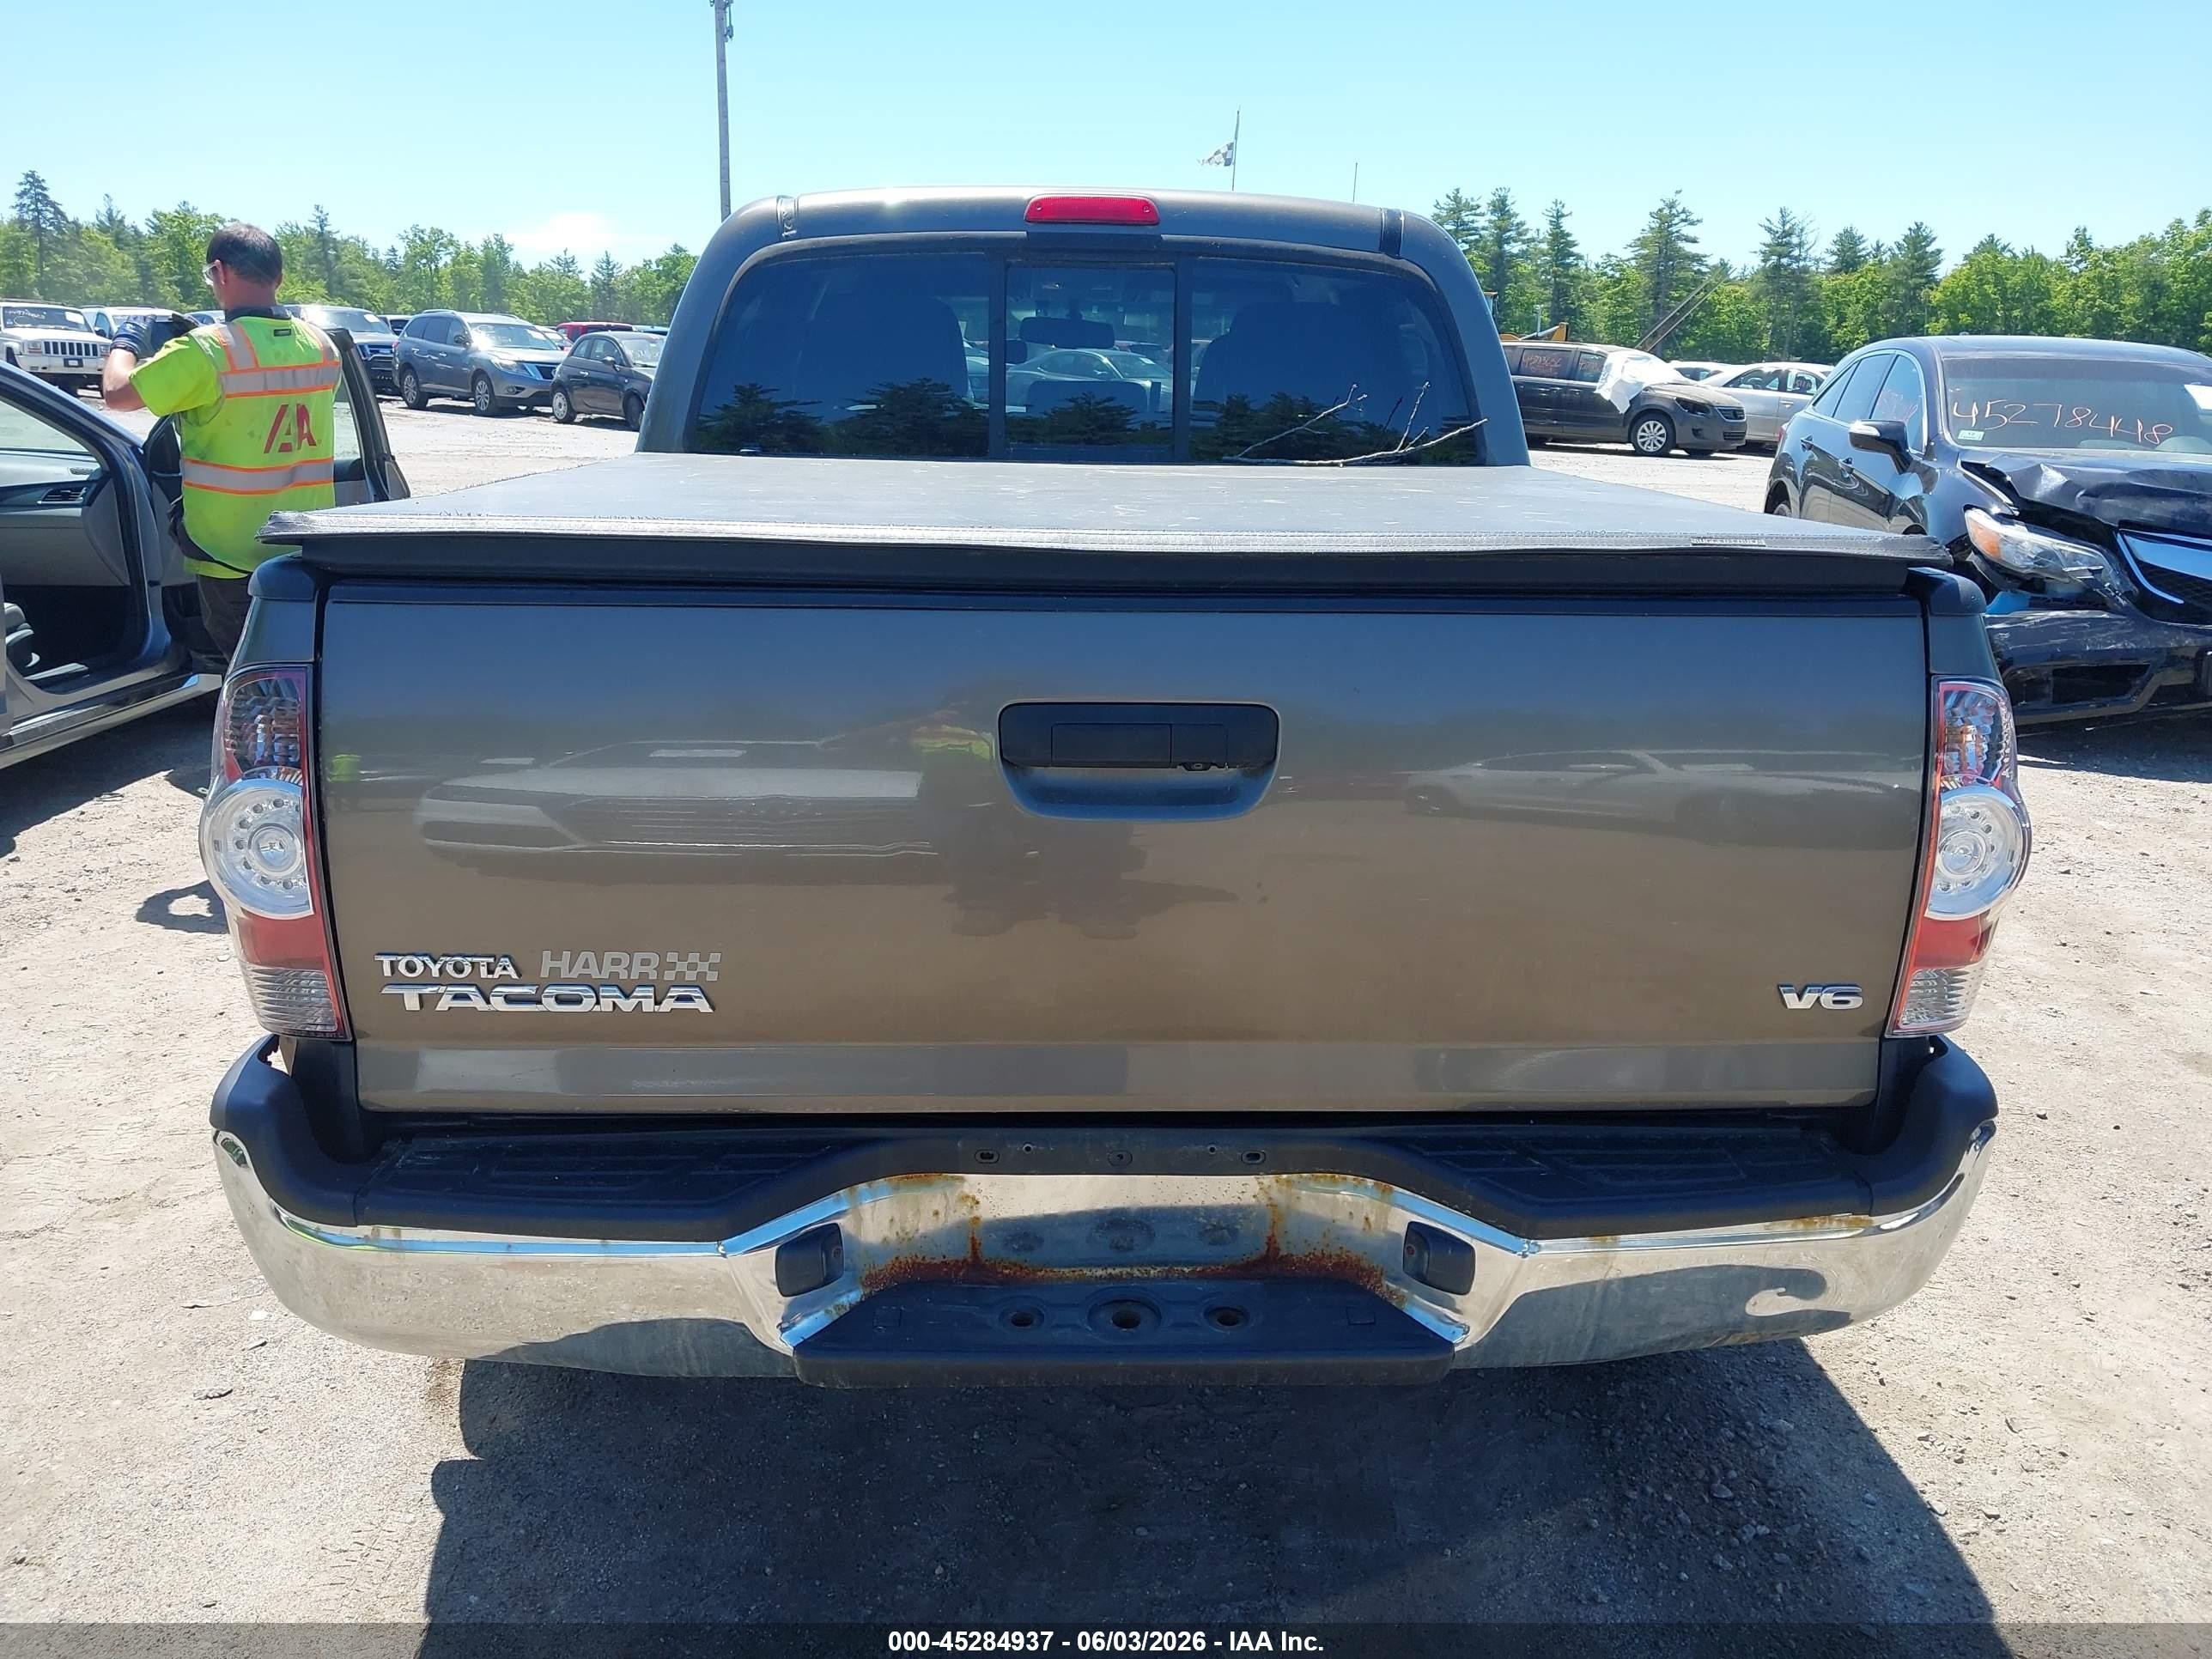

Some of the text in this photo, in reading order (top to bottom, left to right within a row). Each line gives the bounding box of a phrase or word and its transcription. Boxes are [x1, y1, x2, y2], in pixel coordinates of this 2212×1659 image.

[374, 953, 522, 979] TOYOTA
[540, 950, 659, 980] HARR
[381, 984, 714, 1013] TACOMA
[1778, 985, 1863, 1010] V6
